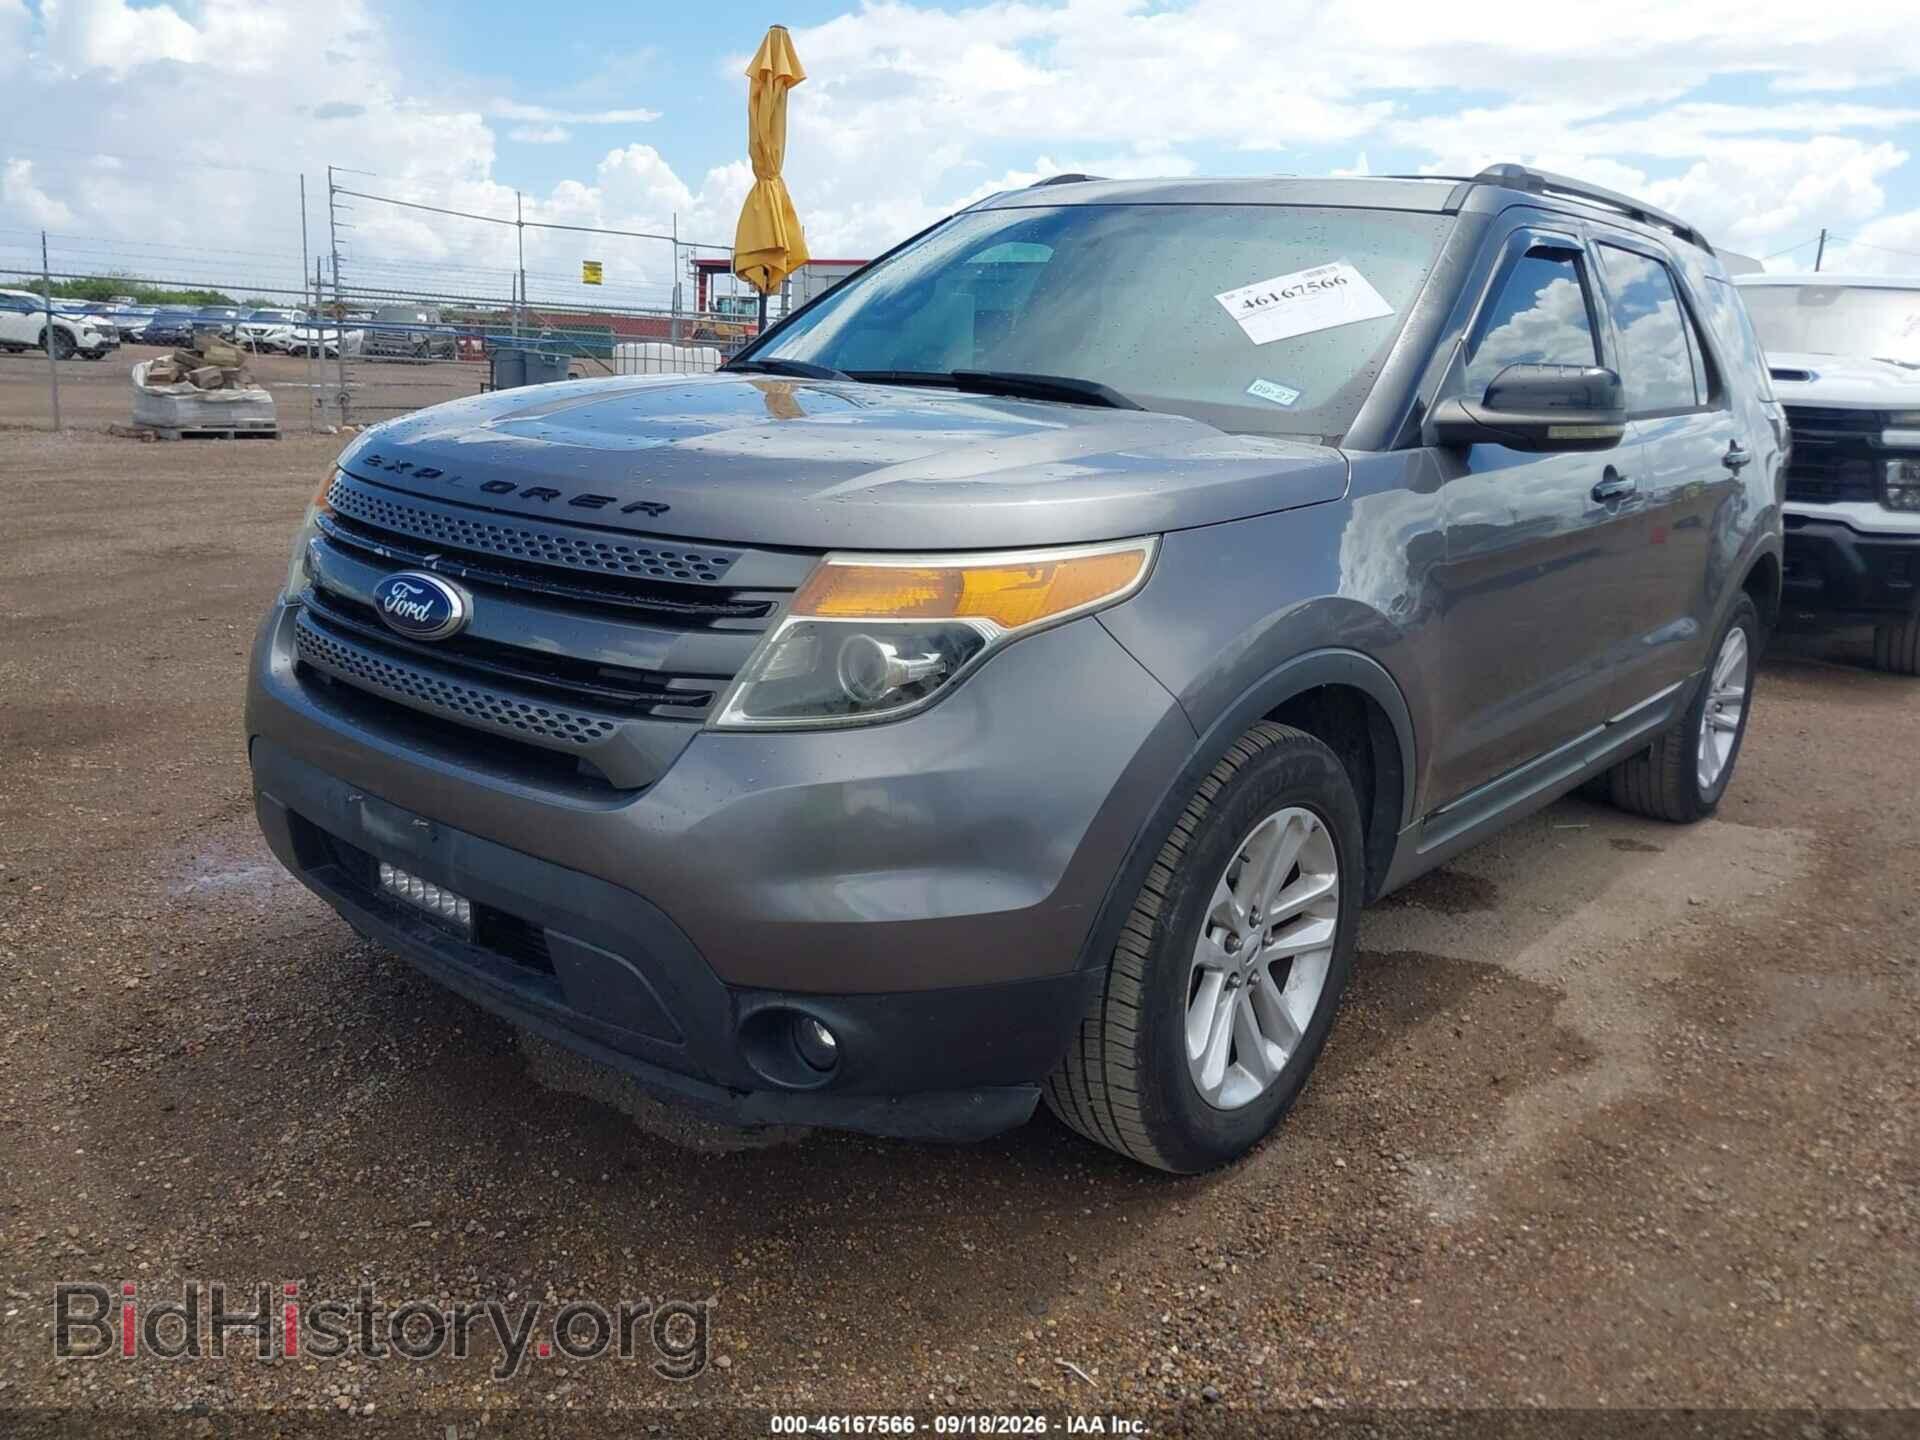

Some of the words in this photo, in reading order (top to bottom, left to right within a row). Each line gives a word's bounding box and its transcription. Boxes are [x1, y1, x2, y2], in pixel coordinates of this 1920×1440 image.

[1241, 274, 1348, 310] 46167566
[362, 454, 671, 518] EXPLORER
[384, 582, 434, 624] Ford
